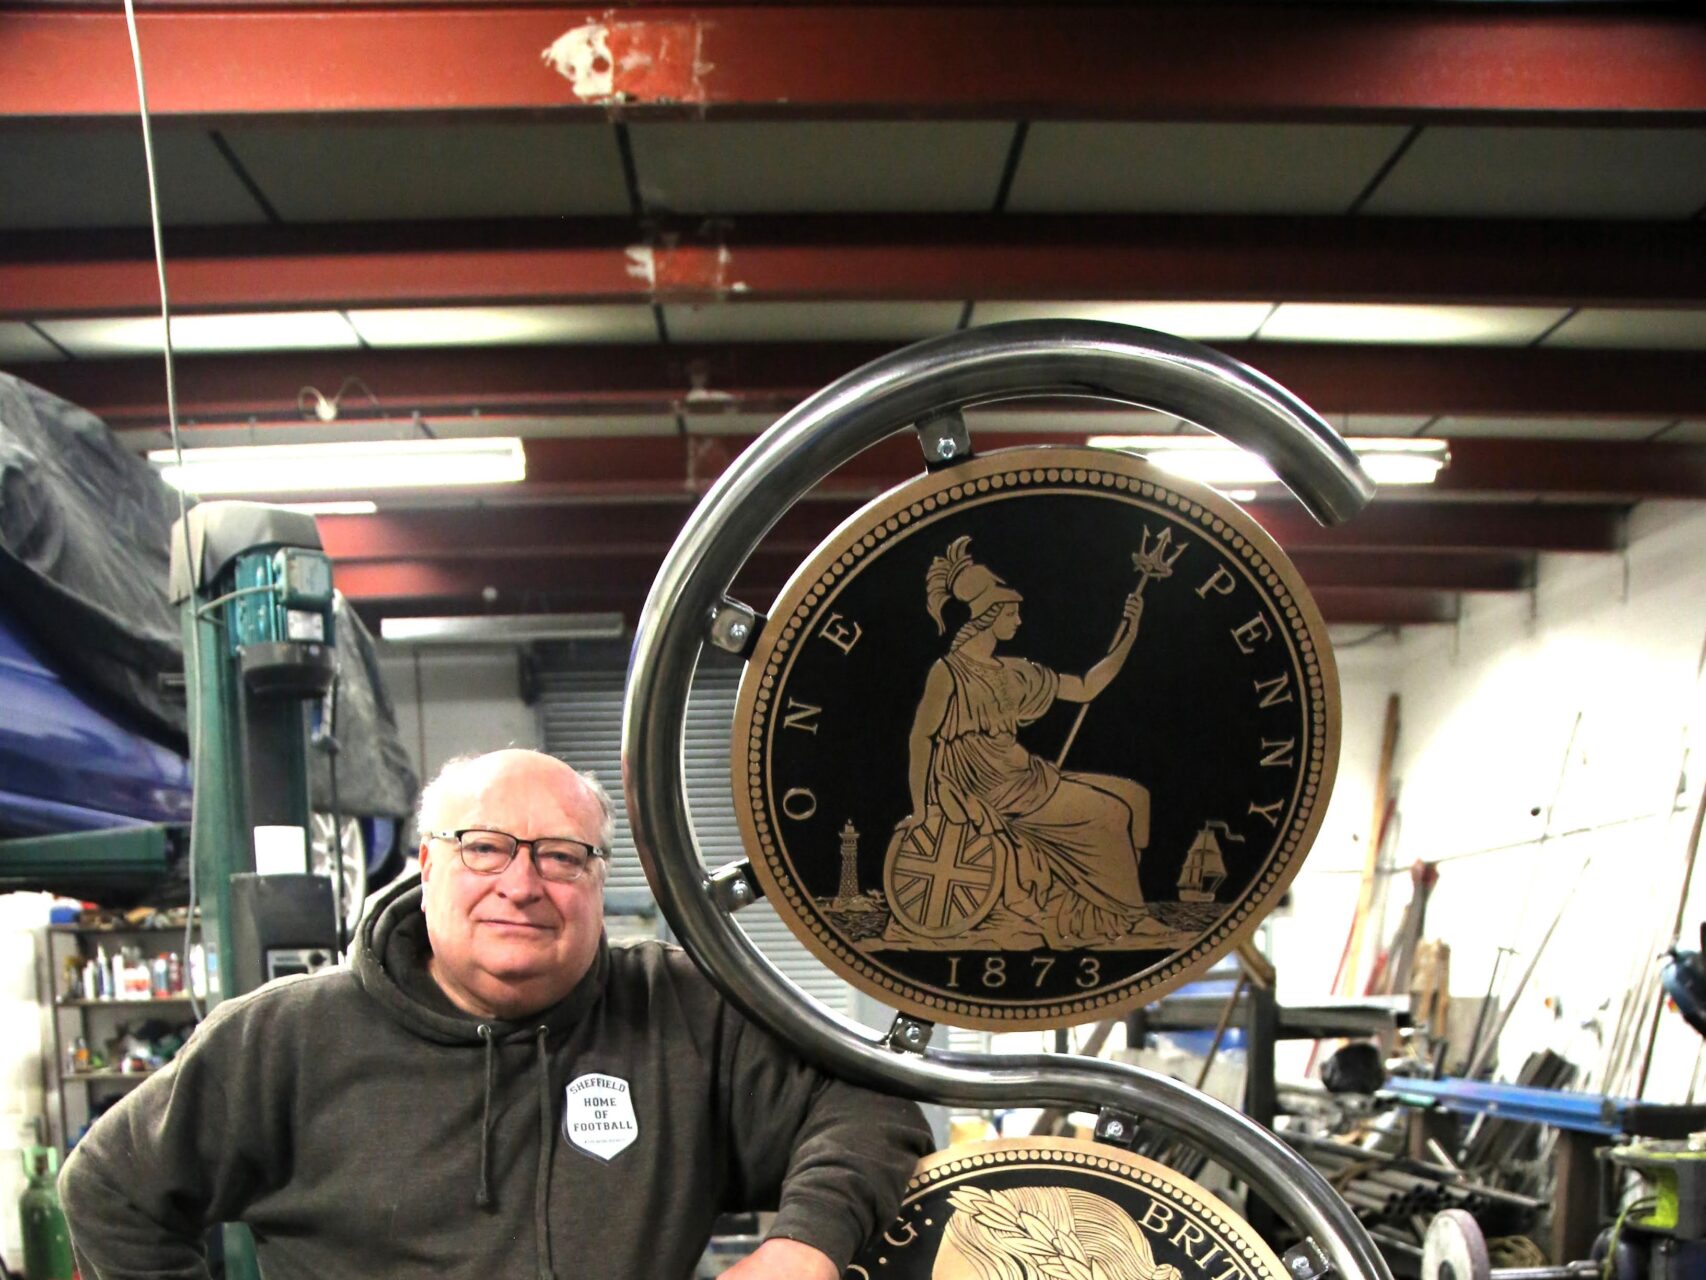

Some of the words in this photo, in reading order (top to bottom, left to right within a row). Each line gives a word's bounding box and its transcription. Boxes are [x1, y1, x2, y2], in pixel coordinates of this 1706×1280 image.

[783, 613, 864, 821] ONE
[1195, 564, 1293, 829] PENNY
[946, 957, 1102, 988] 1873
[569, 1078, 626, 1094] SHEFFIELD
[584, 1097, 616, 1107] HOME
[594, 1110, 608, 1119] OF
[573, 1121, 633, 1132] FOOTBALL
